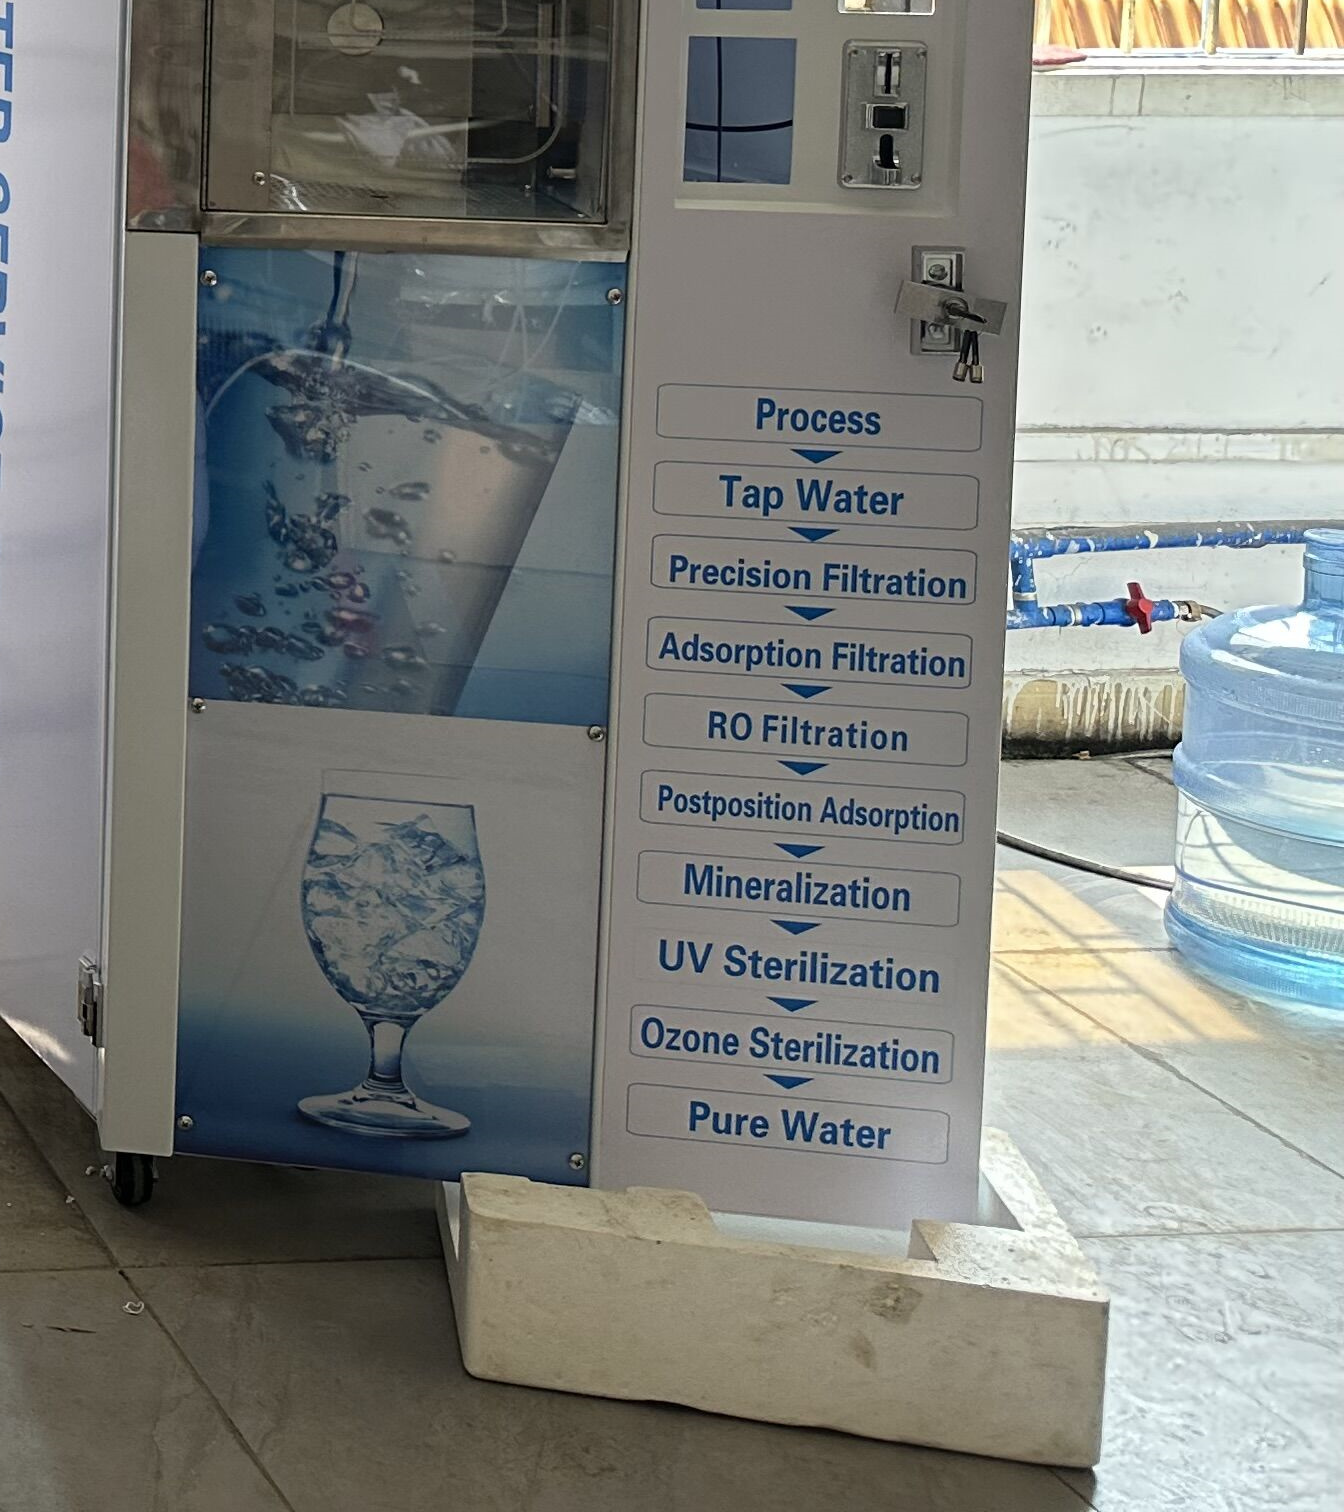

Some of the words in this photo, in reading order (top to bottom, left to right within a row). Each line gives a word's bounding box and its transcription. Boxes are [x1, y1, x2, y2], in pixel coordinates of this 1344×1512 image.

[756, 398, 881, 435] Process
[719, 475, 783, 517] Tap
[796, 478, 904, 515] Water
[669, 555, 811, 590] Precision
[823, 563, 967, 599] Filtration
[659, 632, 821, 671] Adsorption
[832, 642, 965, 678] Filtration
[708, 711, 752, 741] RO
[763, 715, 908, 751] Filtration
[658, 785, 812, 822] Postposition
[820, 797, 959, 834] Adsorption
[684, 863, 911, 911] Mineralization
[659, 939, 712, 974] UV
[724, 945, 940, 993] Sterilization
[641, 1017, 739, 1055] Ozone
[749, 1027, 940, 1074] Sterilization
[689, 1101, 769, 1138] Pure
[781, 1110, 891, 1150] Water
